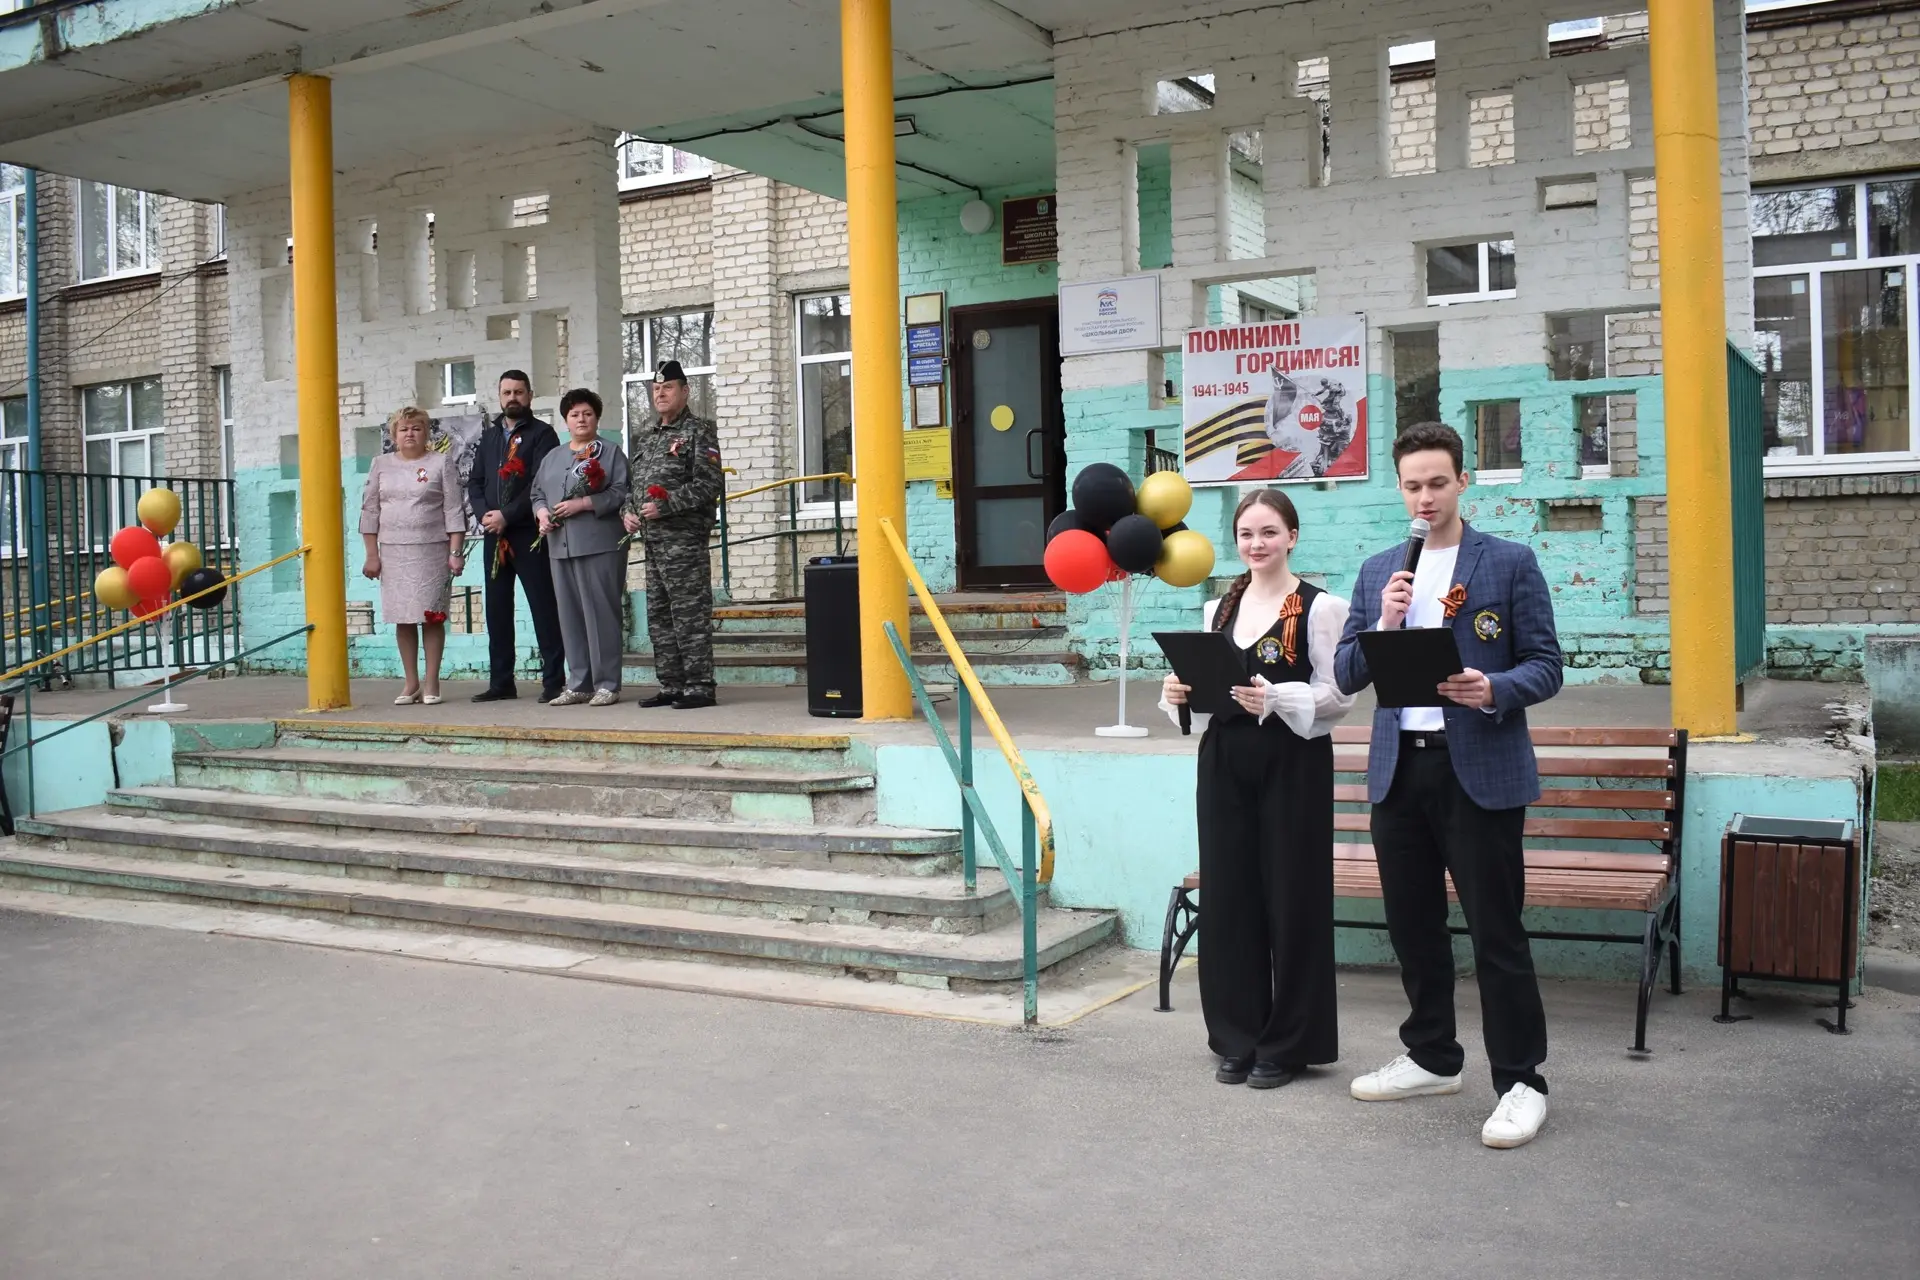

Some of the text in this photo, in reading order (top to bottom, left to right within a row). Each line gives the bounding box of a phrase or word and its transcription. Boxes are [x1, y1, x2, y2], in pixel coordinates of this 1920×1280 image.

[1188, 323, 1301, 353] ПОМНИМ!
[1236, 345, 1360, 375] ГОРДИМСЯ!
[1192, 382, 1249, 397] 1941-1945
[1300, 412, 1320, 423] МАЯ
